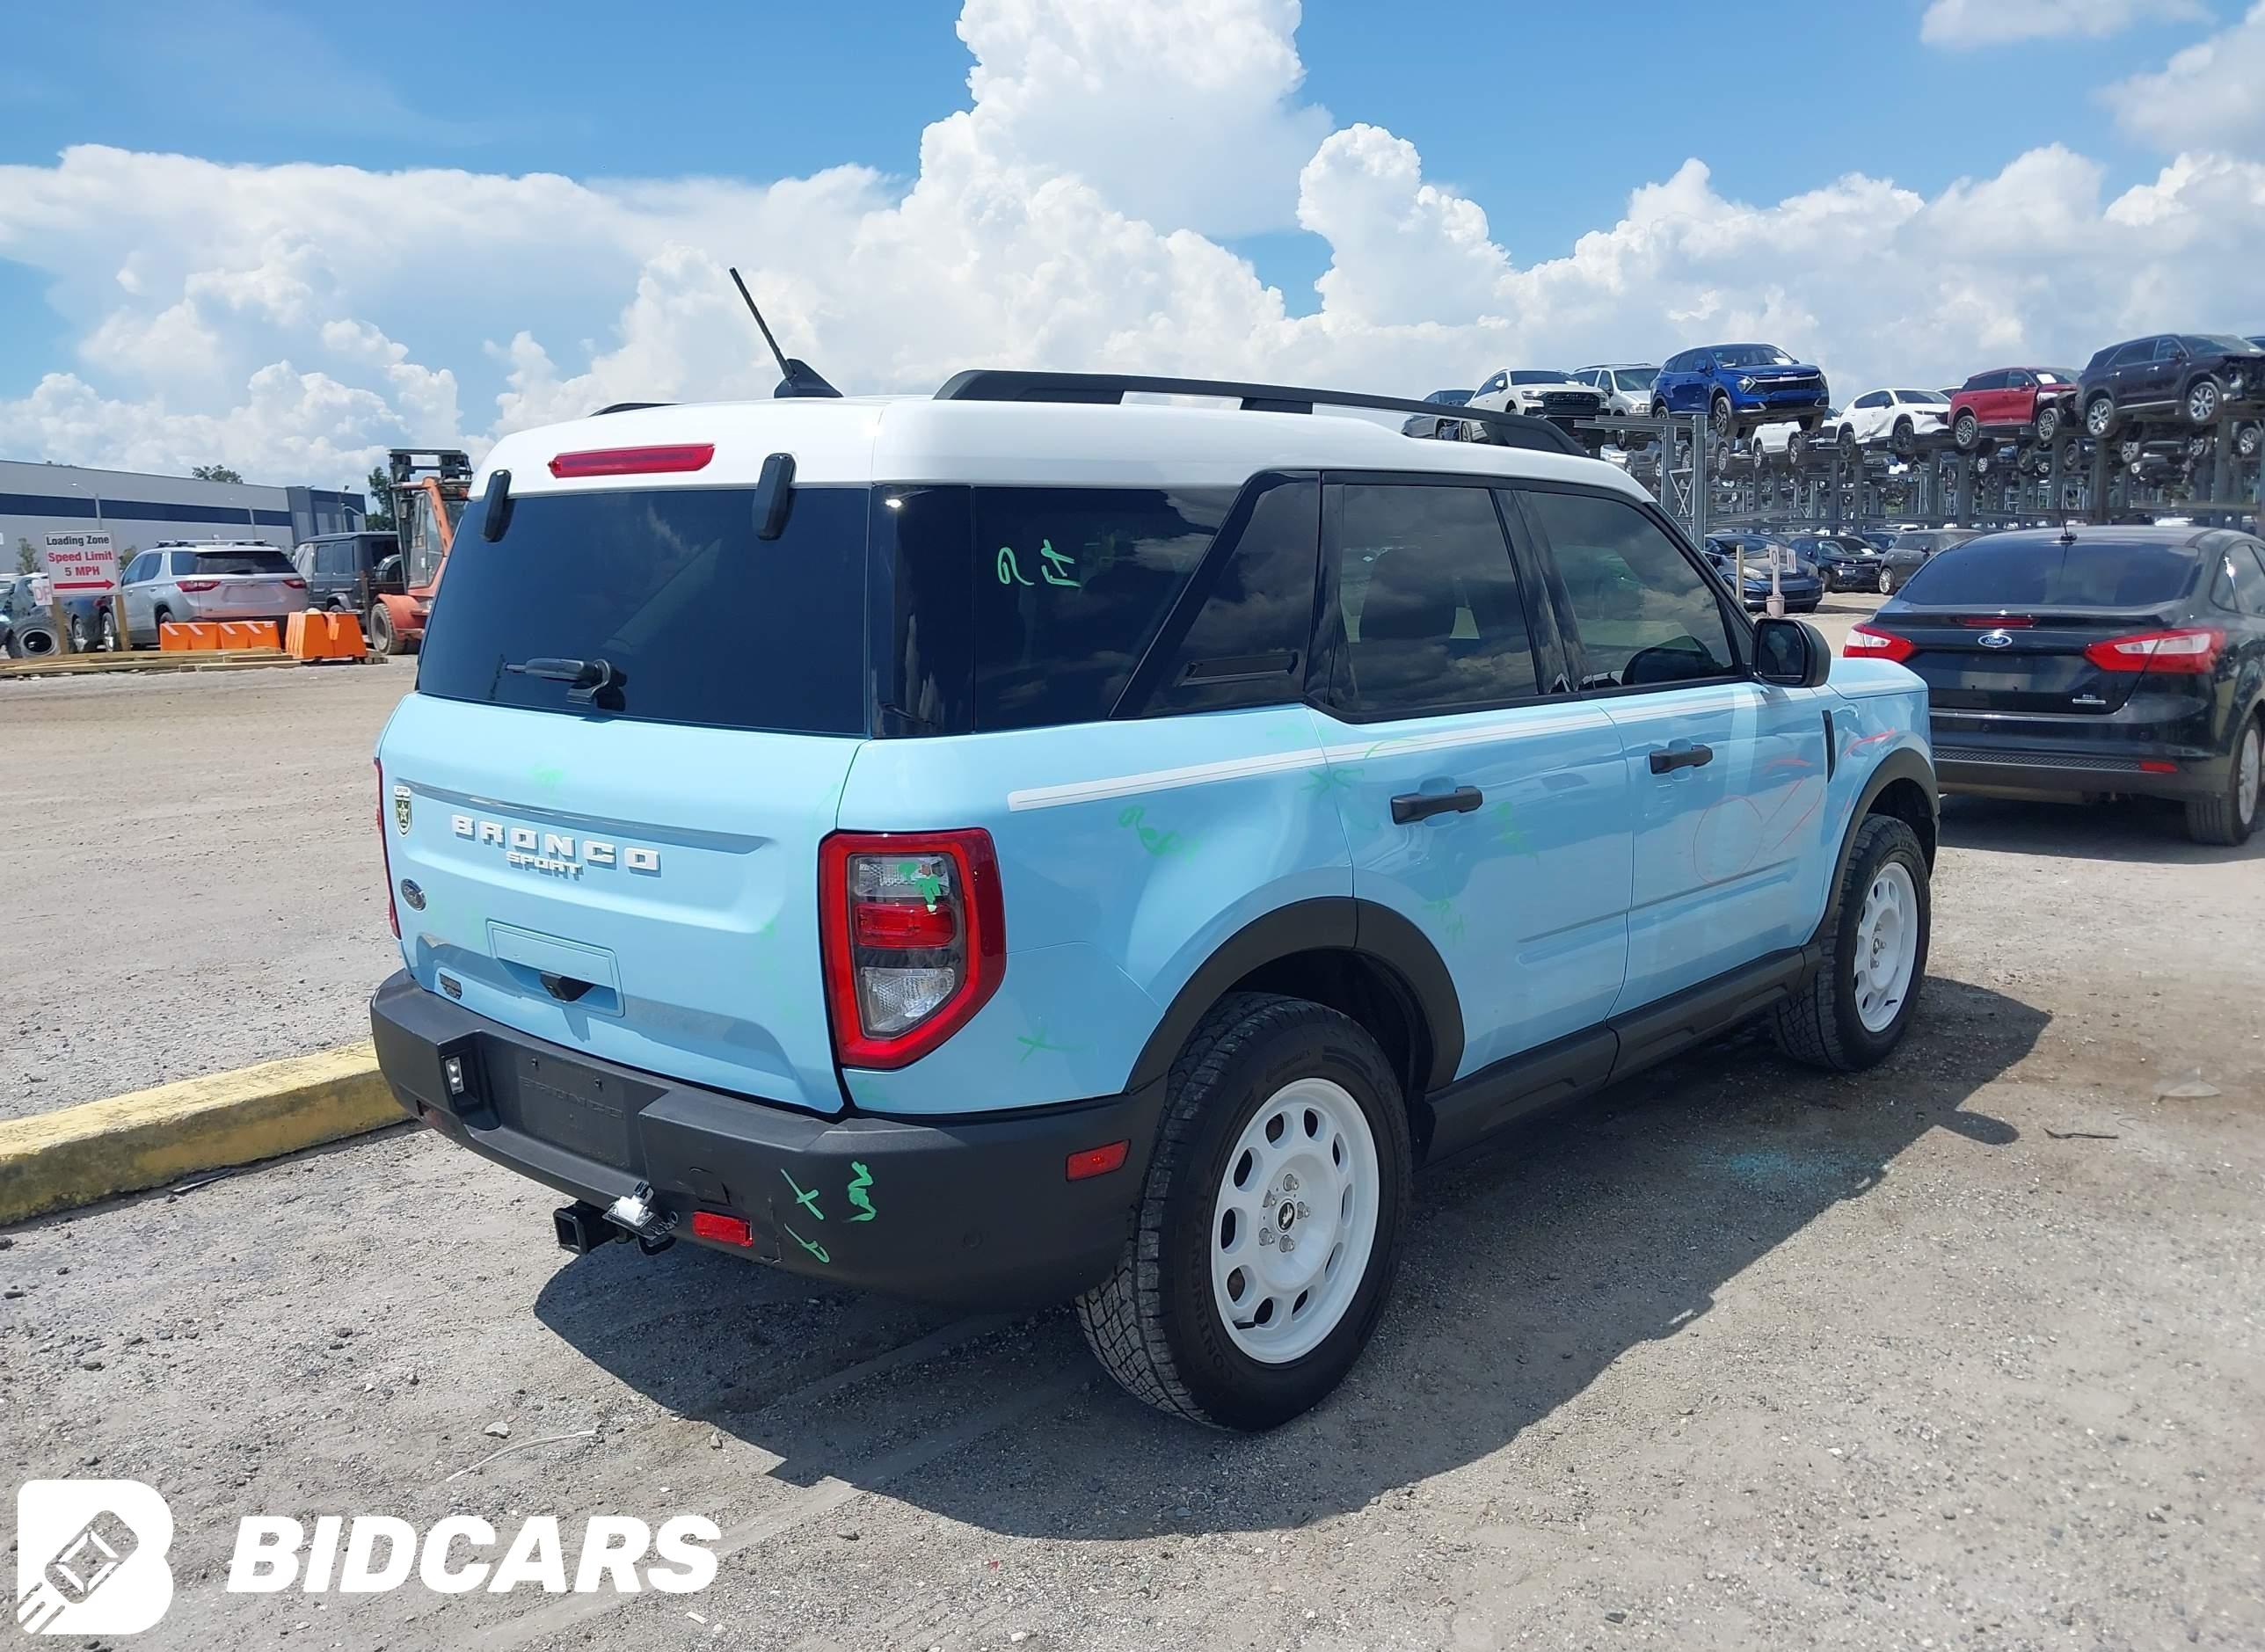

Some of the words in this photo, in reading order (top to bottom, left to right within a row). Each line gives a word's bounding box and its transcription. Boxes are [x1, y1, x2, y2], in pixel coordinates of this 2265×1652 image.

[47, 536, 84, 546] Loading
[86, 535, 109, 544] Zone
[48, 552, 82, 564] Speed
[84, 551, 113, 561] Limit
[65, 567, 71, 576] 5
[76, 566, 99, 576] MPH
[451, 814, 659, 870] BRONCO
[506, 851, 583, 874] SPORT
